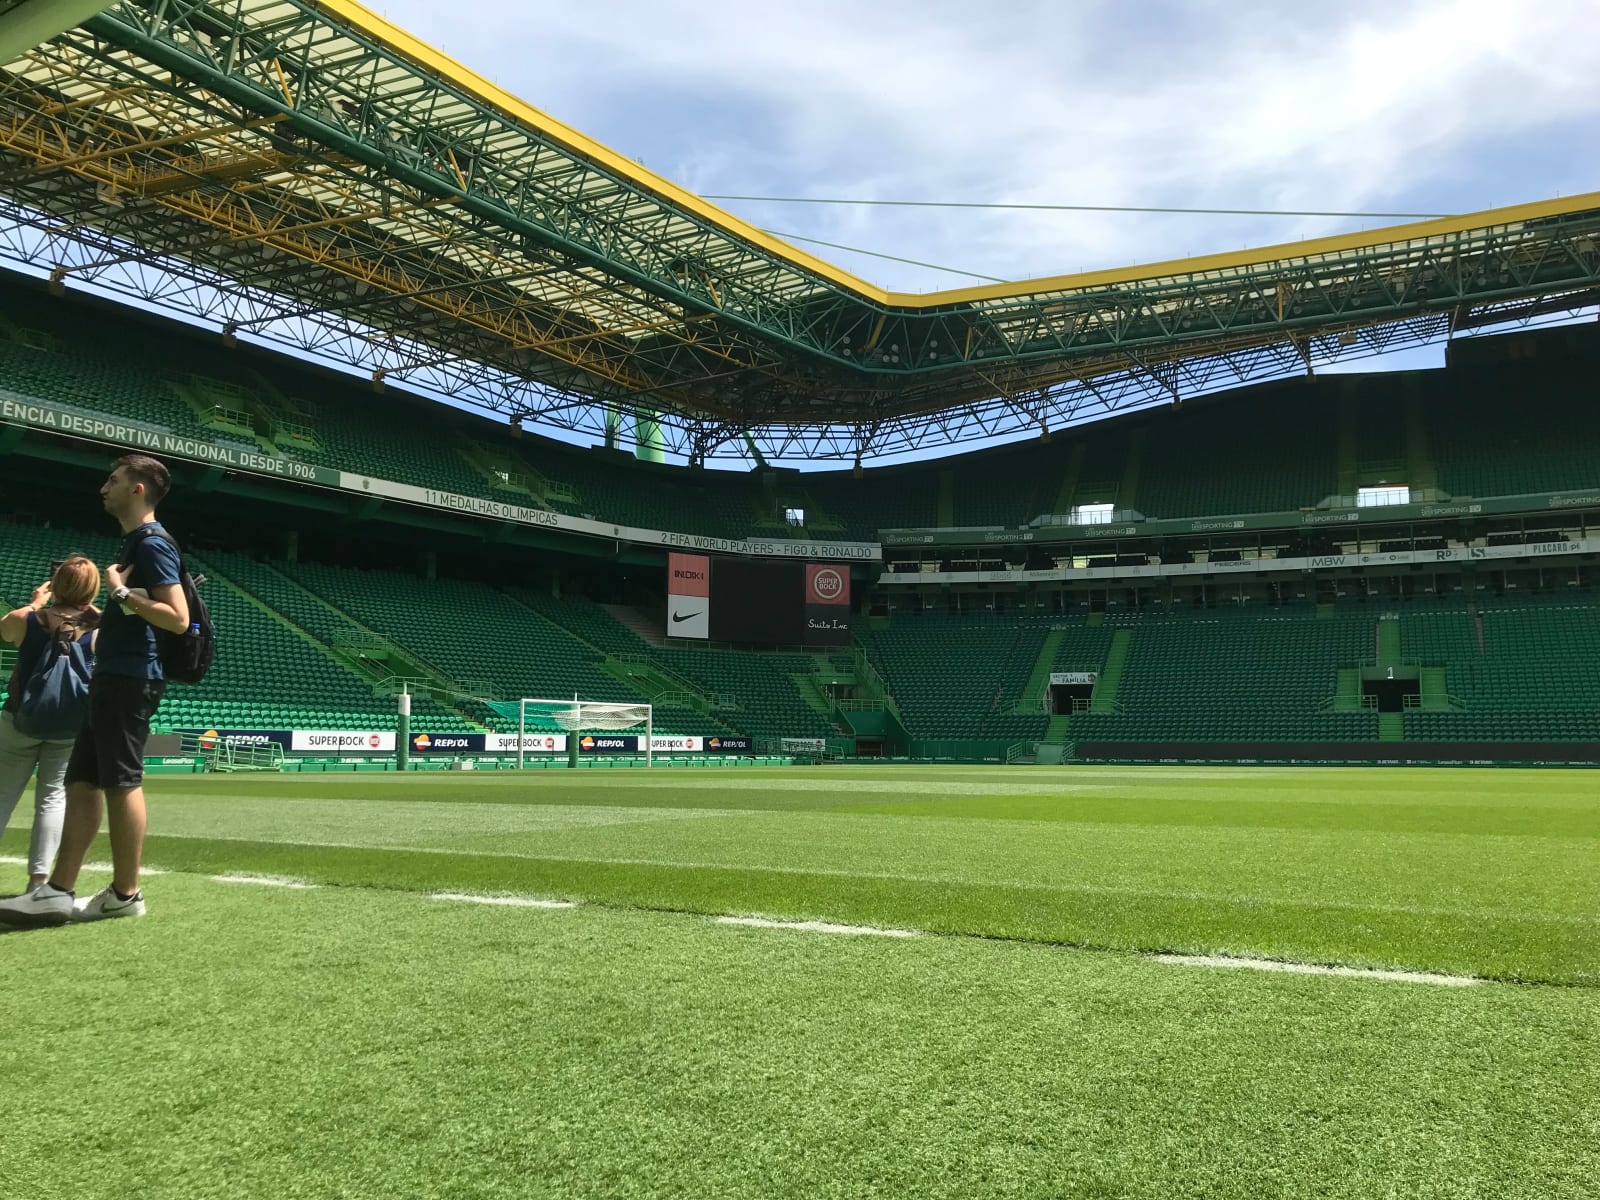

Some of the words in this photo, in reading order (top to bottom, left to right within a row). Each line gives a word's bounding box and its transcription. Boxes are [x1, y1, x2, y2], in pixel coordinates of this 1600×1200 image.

[0, 400, 56, 426] ÊNCIA
[61, 414, 160, 448] DESPORTIVA
[164, 437, 236, 464] NACIONAL
[240, 453, 283, 473] DESDE
[287, 463, 316, 479] 1906
[424, 490, 437, 504] 11
[440, 494, 499, 516] MEDALHAS
[502, 505, 558, 526] OLÍMPICAS
[661, 532, 668, 543] 2
[670, 534, 690, 545] FIFA
[694, 537, 728, 550] WORLD
[730, 541, 774, 553] PLAYERS
[784, 544, 808, 555] FIGO
[810, 545, 818, 556] &
[821, 545, 872, 558] RONALDO
[1311, 556, 1346, 568] MBW
[1386, 666, 1395, 680] 1
[226, 735, 270, 745] REPSOL
[308, 735, 338, 746] SUPER
[338, 735, 365, 746] BOCK
[434, 738, 470, 747] REPSOL
[522, 738, 542, 747] BOCK
[596, 739, 625, 748] REPSOL
[650, 739, 667, 748] UPER
[668, 739, 683, 748] BOCK
[722, 740, 747, 748] REPSOL
